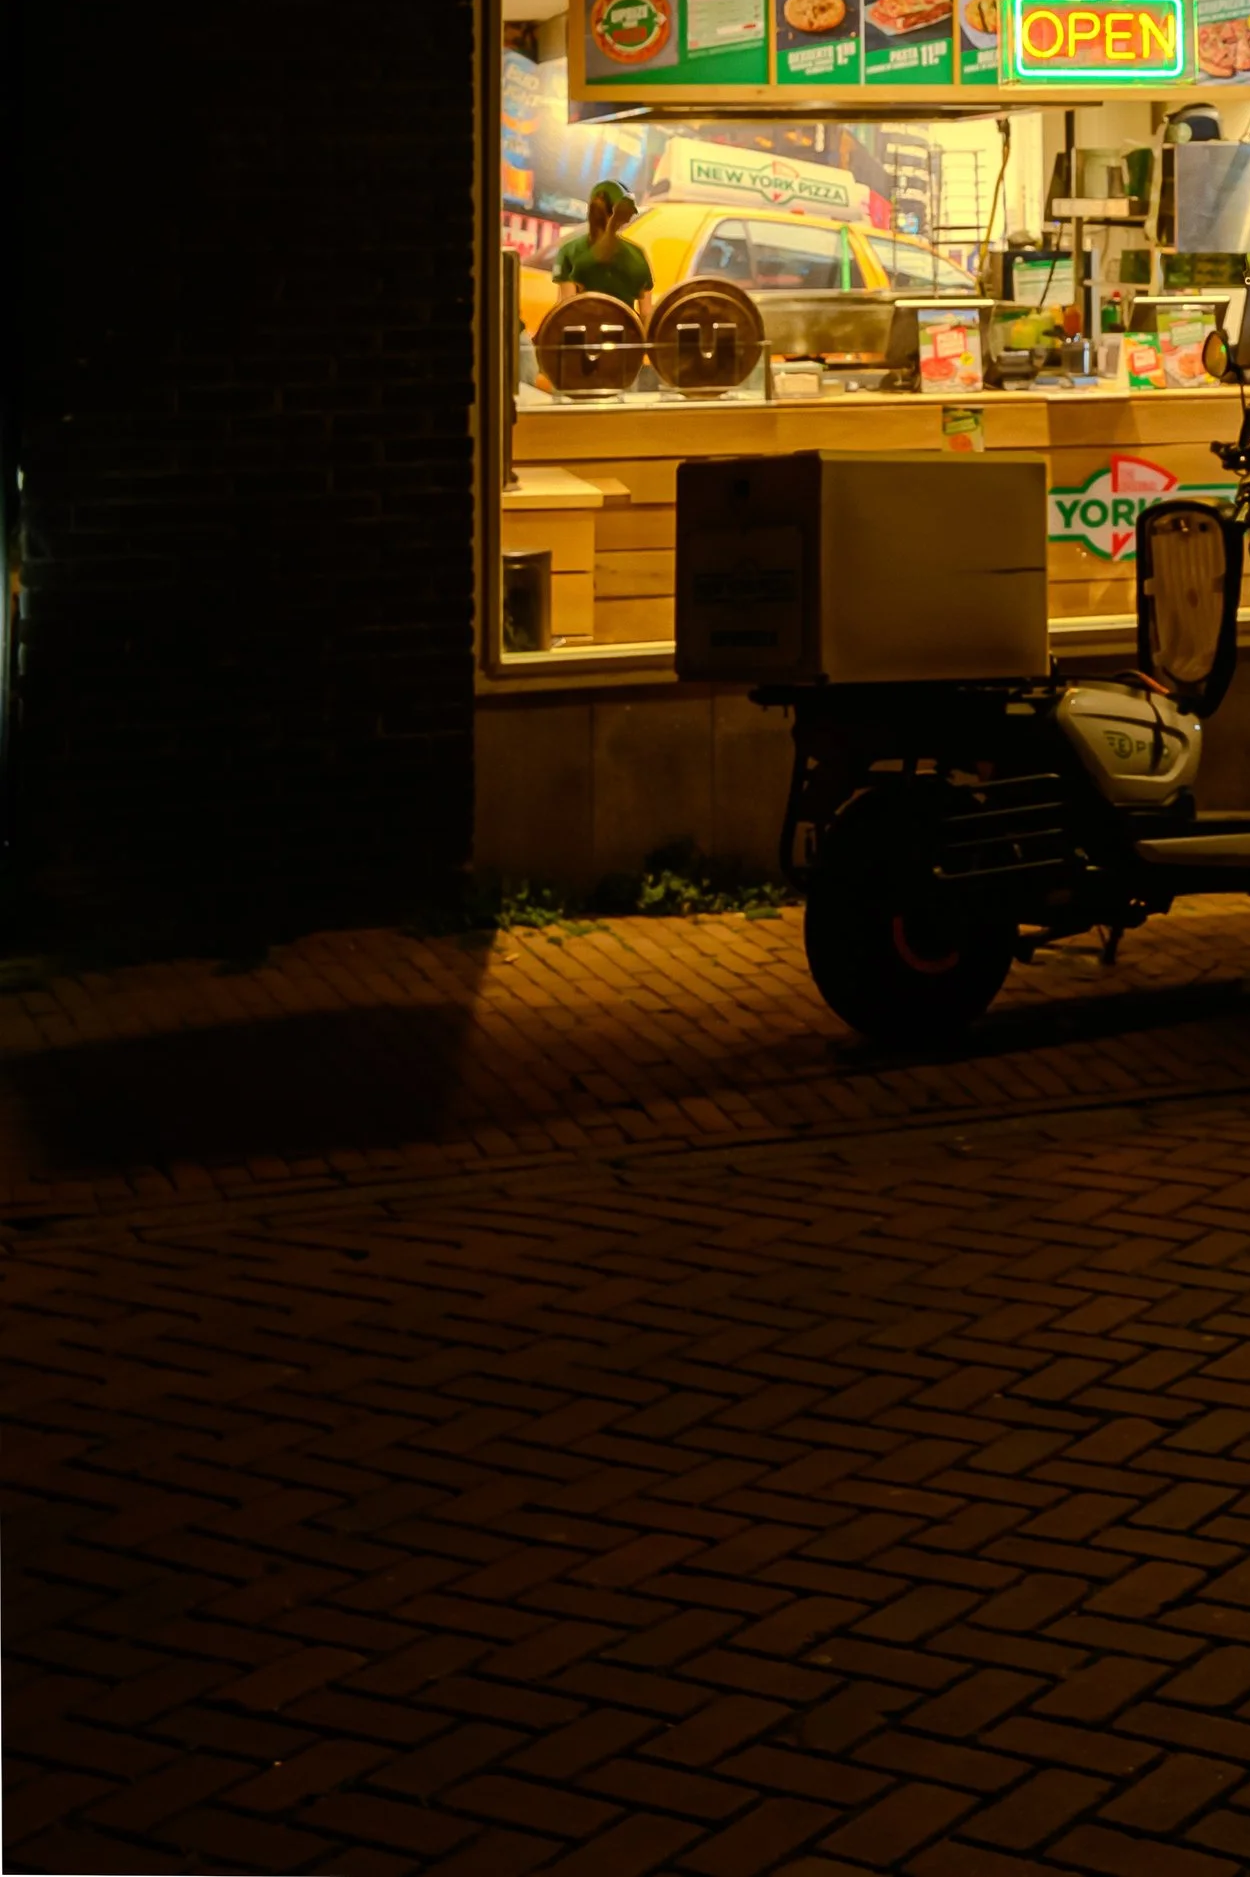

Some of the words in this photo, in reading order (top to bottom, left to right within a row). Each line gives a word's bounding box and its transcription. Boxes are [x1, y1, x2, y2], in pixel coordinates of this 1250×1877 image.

[1021, 9, 1177, 60] OPEN
[697, 164, 743, 183] NEW
[749, 174, 794, 192] YORK
[799, 183, 843, 201] PIZZA
